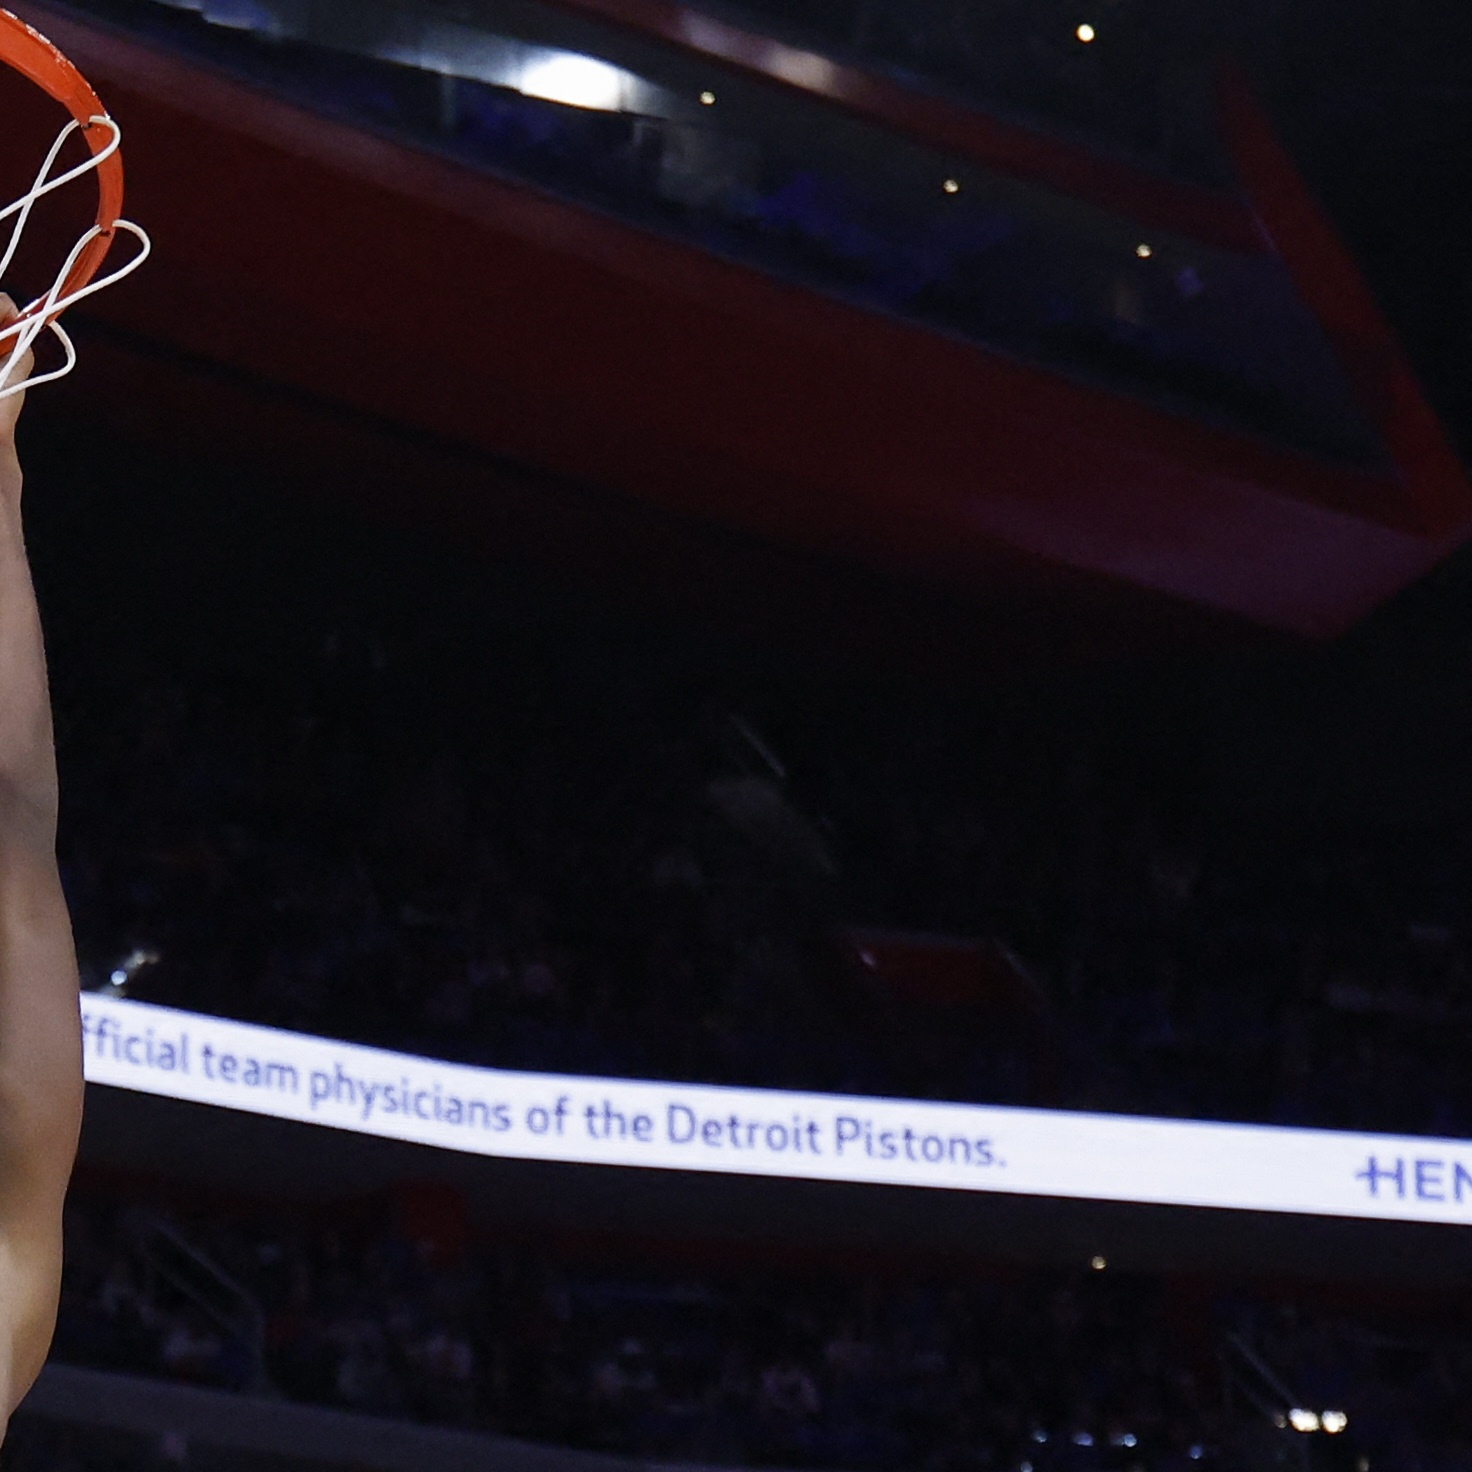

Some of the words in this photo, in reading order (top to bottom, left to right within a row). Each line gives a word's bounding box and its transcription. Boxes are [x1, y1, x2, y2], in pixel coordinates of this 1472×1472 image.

[202, 1042, 299, 1094] team
[309, 1061, 512, 1133] physicians
[526, 1095, 570, 1136] of
[585, 1100, 654, 1142] the
[667, 1103, 823, 1155] Detroit
[835, 1115, 1007, 1168] Pistons.
